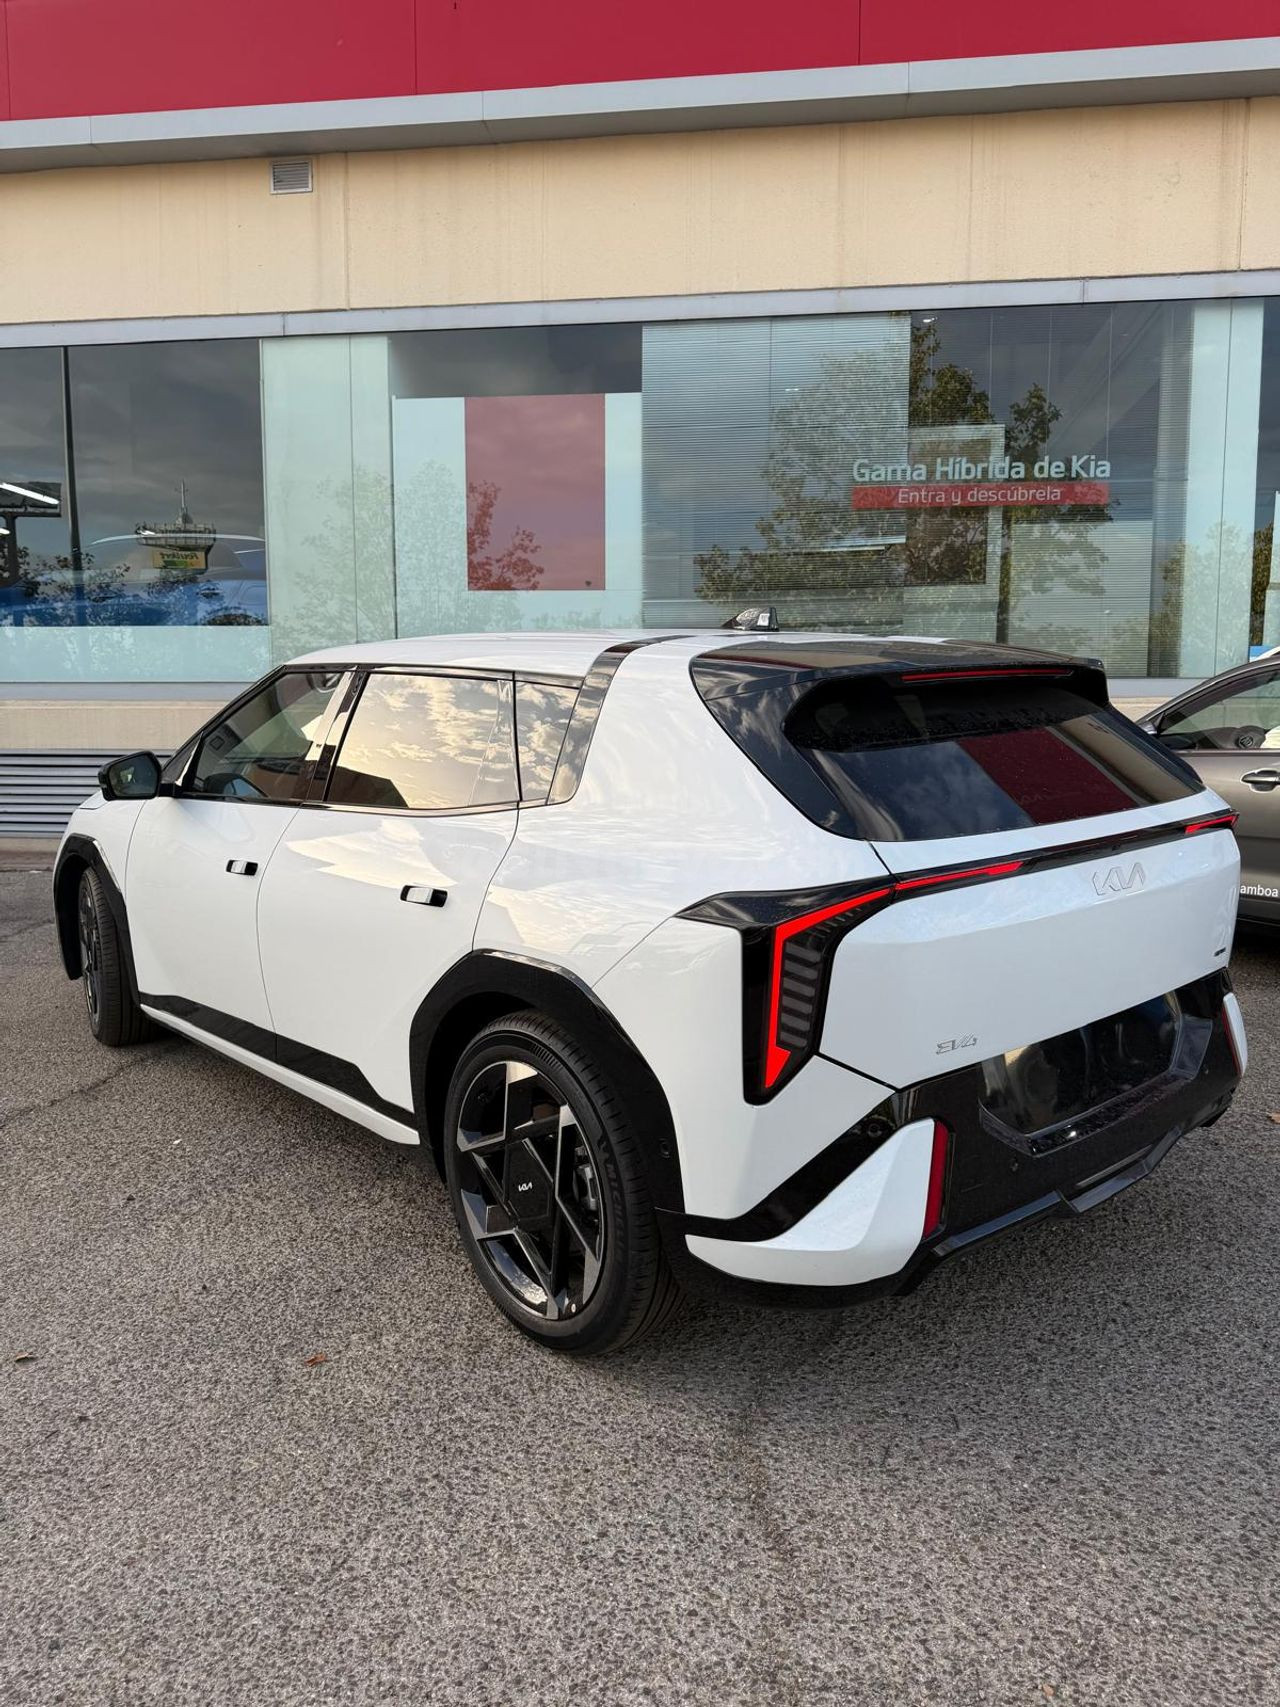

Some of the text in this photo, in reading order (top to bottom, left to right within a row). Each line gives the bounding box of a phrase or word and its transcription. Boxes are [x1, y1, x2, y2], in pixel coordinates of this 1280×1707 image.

[853, 455, 1112, 482] Gama Híbrida de Kia
[898, 487, 1061, 505] Entra y descúbrela
[1092, 862, 1146, 896] KIA
[1240, 884, 1280, 897] amboa
[935, 1033, 978, 1055] EV4
